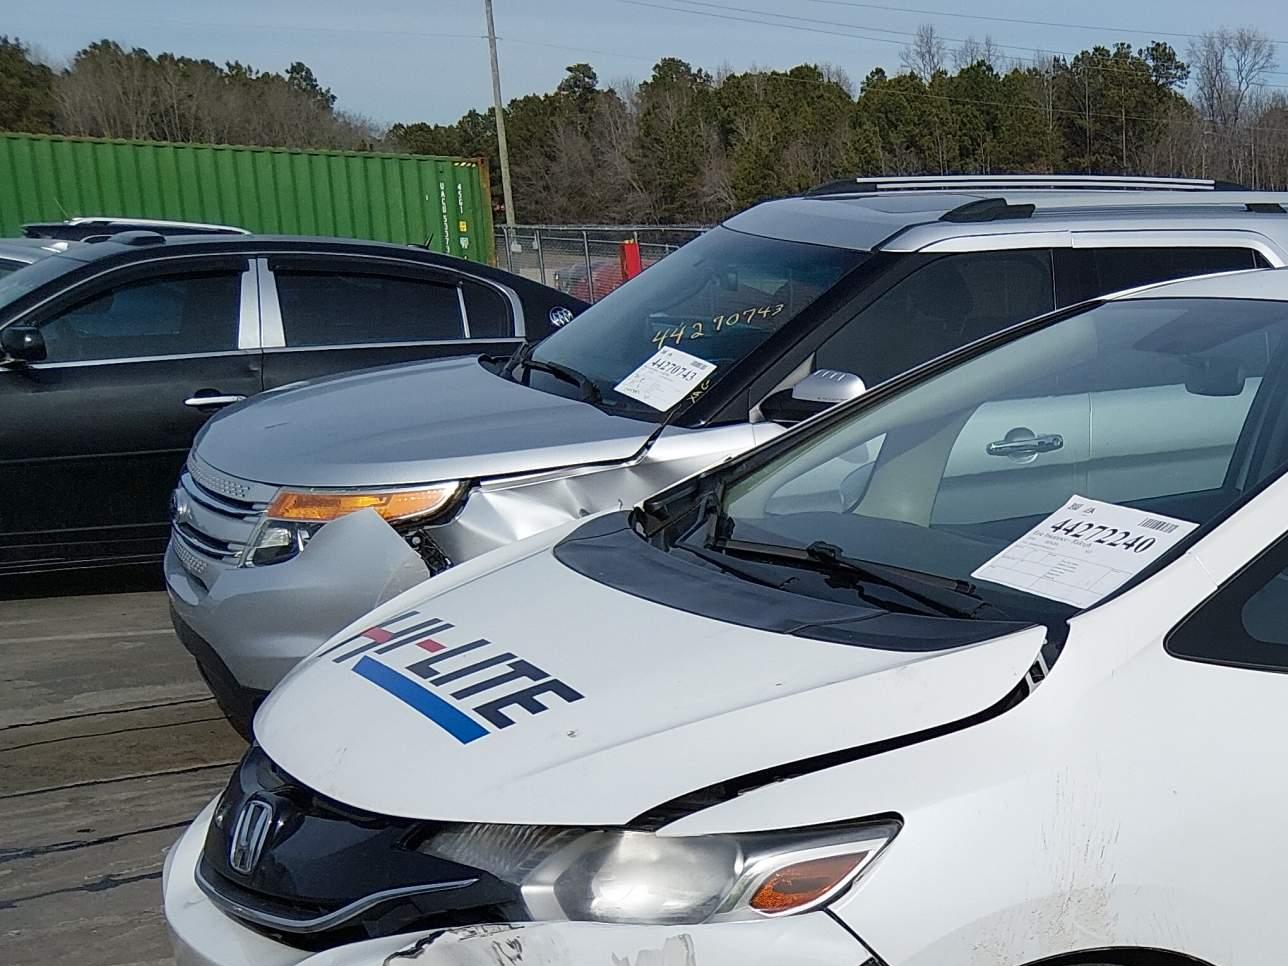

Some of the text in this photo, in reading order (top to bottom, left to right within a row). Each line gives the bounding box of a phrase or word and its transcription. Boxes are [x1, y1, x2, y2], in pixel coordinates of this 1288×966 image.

[651, 359, 697, 380] 44270743
[1051, 519, 1157, 553] 44272240
[317, 610, 586, 730] HI-LITE
